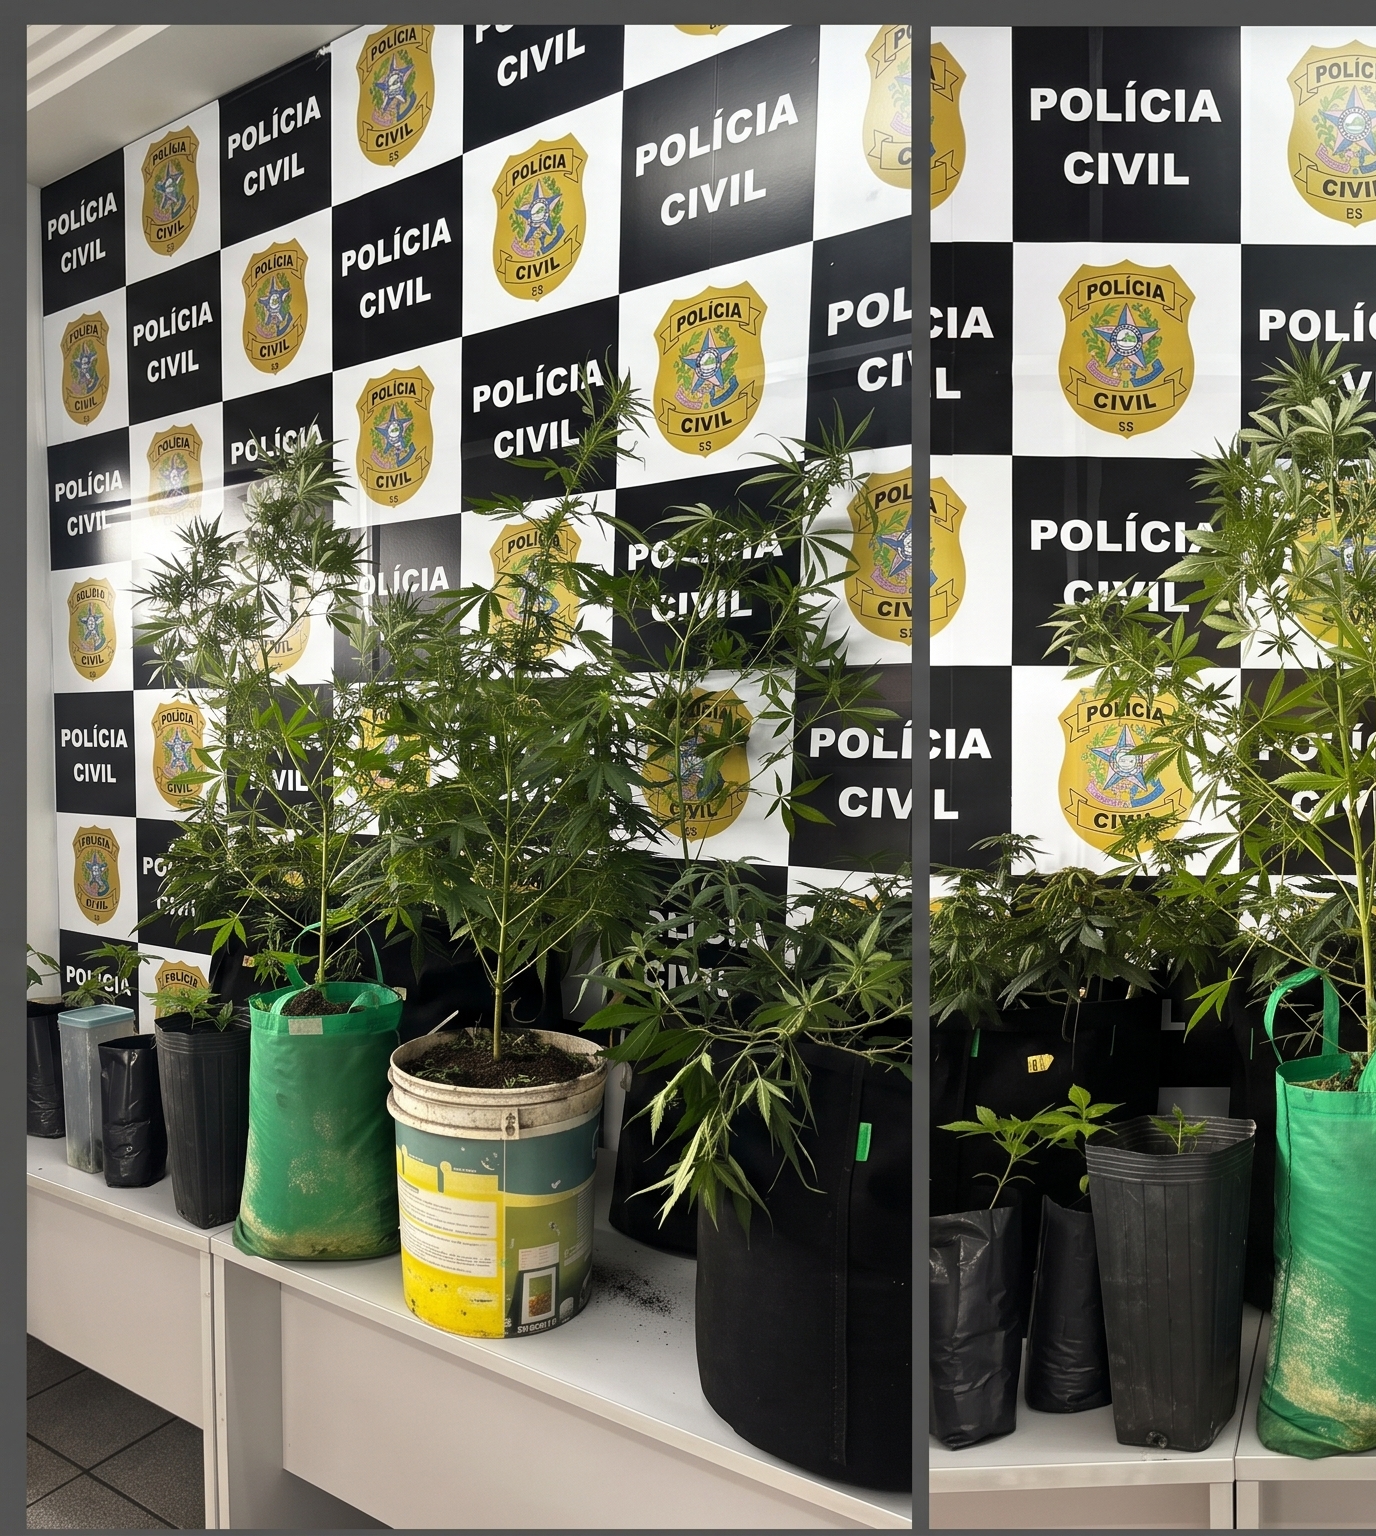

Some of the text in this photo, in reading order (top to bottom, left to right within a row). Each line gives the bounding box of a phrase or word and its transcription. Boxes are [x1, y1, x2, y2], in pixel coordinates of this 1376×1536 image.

[370, 27, 417, 61] POLÍCIA
[497, 28, 586, 87] CIVIL
[1030, 81, 1222, 123] POLÍCIA
[227, 95, 321, 159] POLÍCIA
[375, 124, 413, 149] CIVIL
[635, 93, 799, 178] POLÍCIA
[243, 153, 305, 196] CIVIL
[512, 154, 567, 186] POLÍCIA
[1063, 151, 1190, 186] CIVIL
[660, 169, 767, 227] CIVIL
[47, 192, 118, 240] POLÍCIA
[156, 220, 185, 240] CIVIL
[60, 239, 106, 273] CIVIL
[341, 217, 452, 277] POLÍCIA
[254, 253, 294, 279] POLÍCIA
[515, 258, 560, 282] CIVIL
[359, 276, 431, 320] CIVIL
[1086, 275, 1166, 302] POLÍCIA
[133, 301, 214, 346] POLÍCIA
[677, 302, 742, 332] POLÍCIA
[259, 339, 290, 357] CIVIL
[147, 350, 199, 383] CIVIL
[371, 381, 417, 405] POLÍCIA
[473, 361, 605, 413] POLÍCIA
[1093, 392, 1157, 411] CIVIL
[681, 411, 732, 433] CIVIL
[494, 420, 579, 459] CIVIL
[55, 470, 123, 502] POLÍCIA
[375, 472, 412, 489] CIVIL
[651, 590, 752, 622] CIVIL
[81, 654, 104, 666] CIVIL
[60, 724, 128, 748] POLÍCIA
[73, 763, 116, 783] CIVIL
